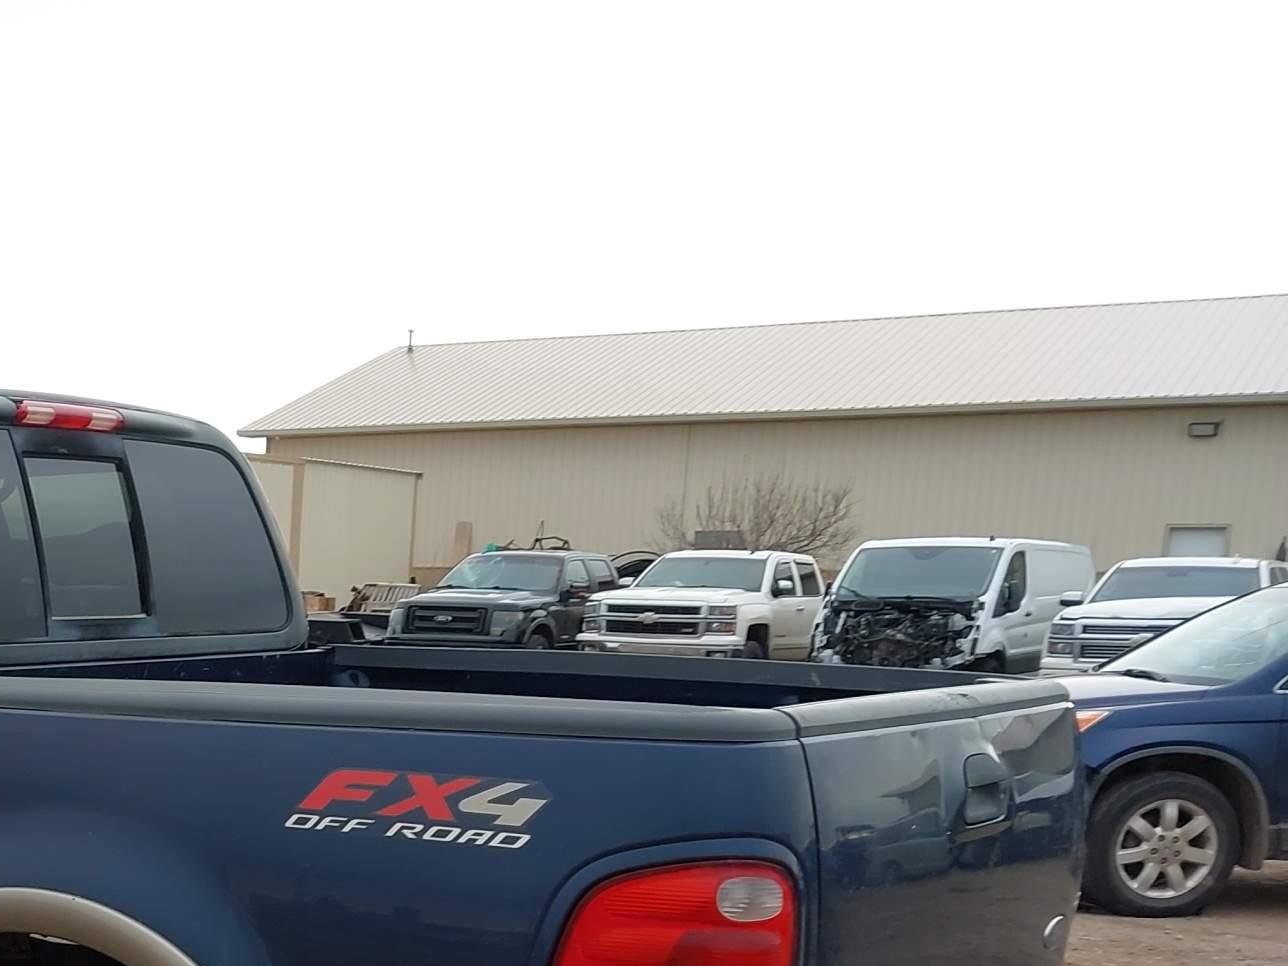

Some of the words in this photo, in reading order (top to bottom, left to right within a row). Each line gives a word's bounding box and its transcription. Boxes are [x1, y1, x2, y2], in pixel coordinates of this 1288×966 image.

[298, 767, 549, 827] FX4
[284, 813, 376, 833] OFF
[384, 822, 532, 849] ROAD
